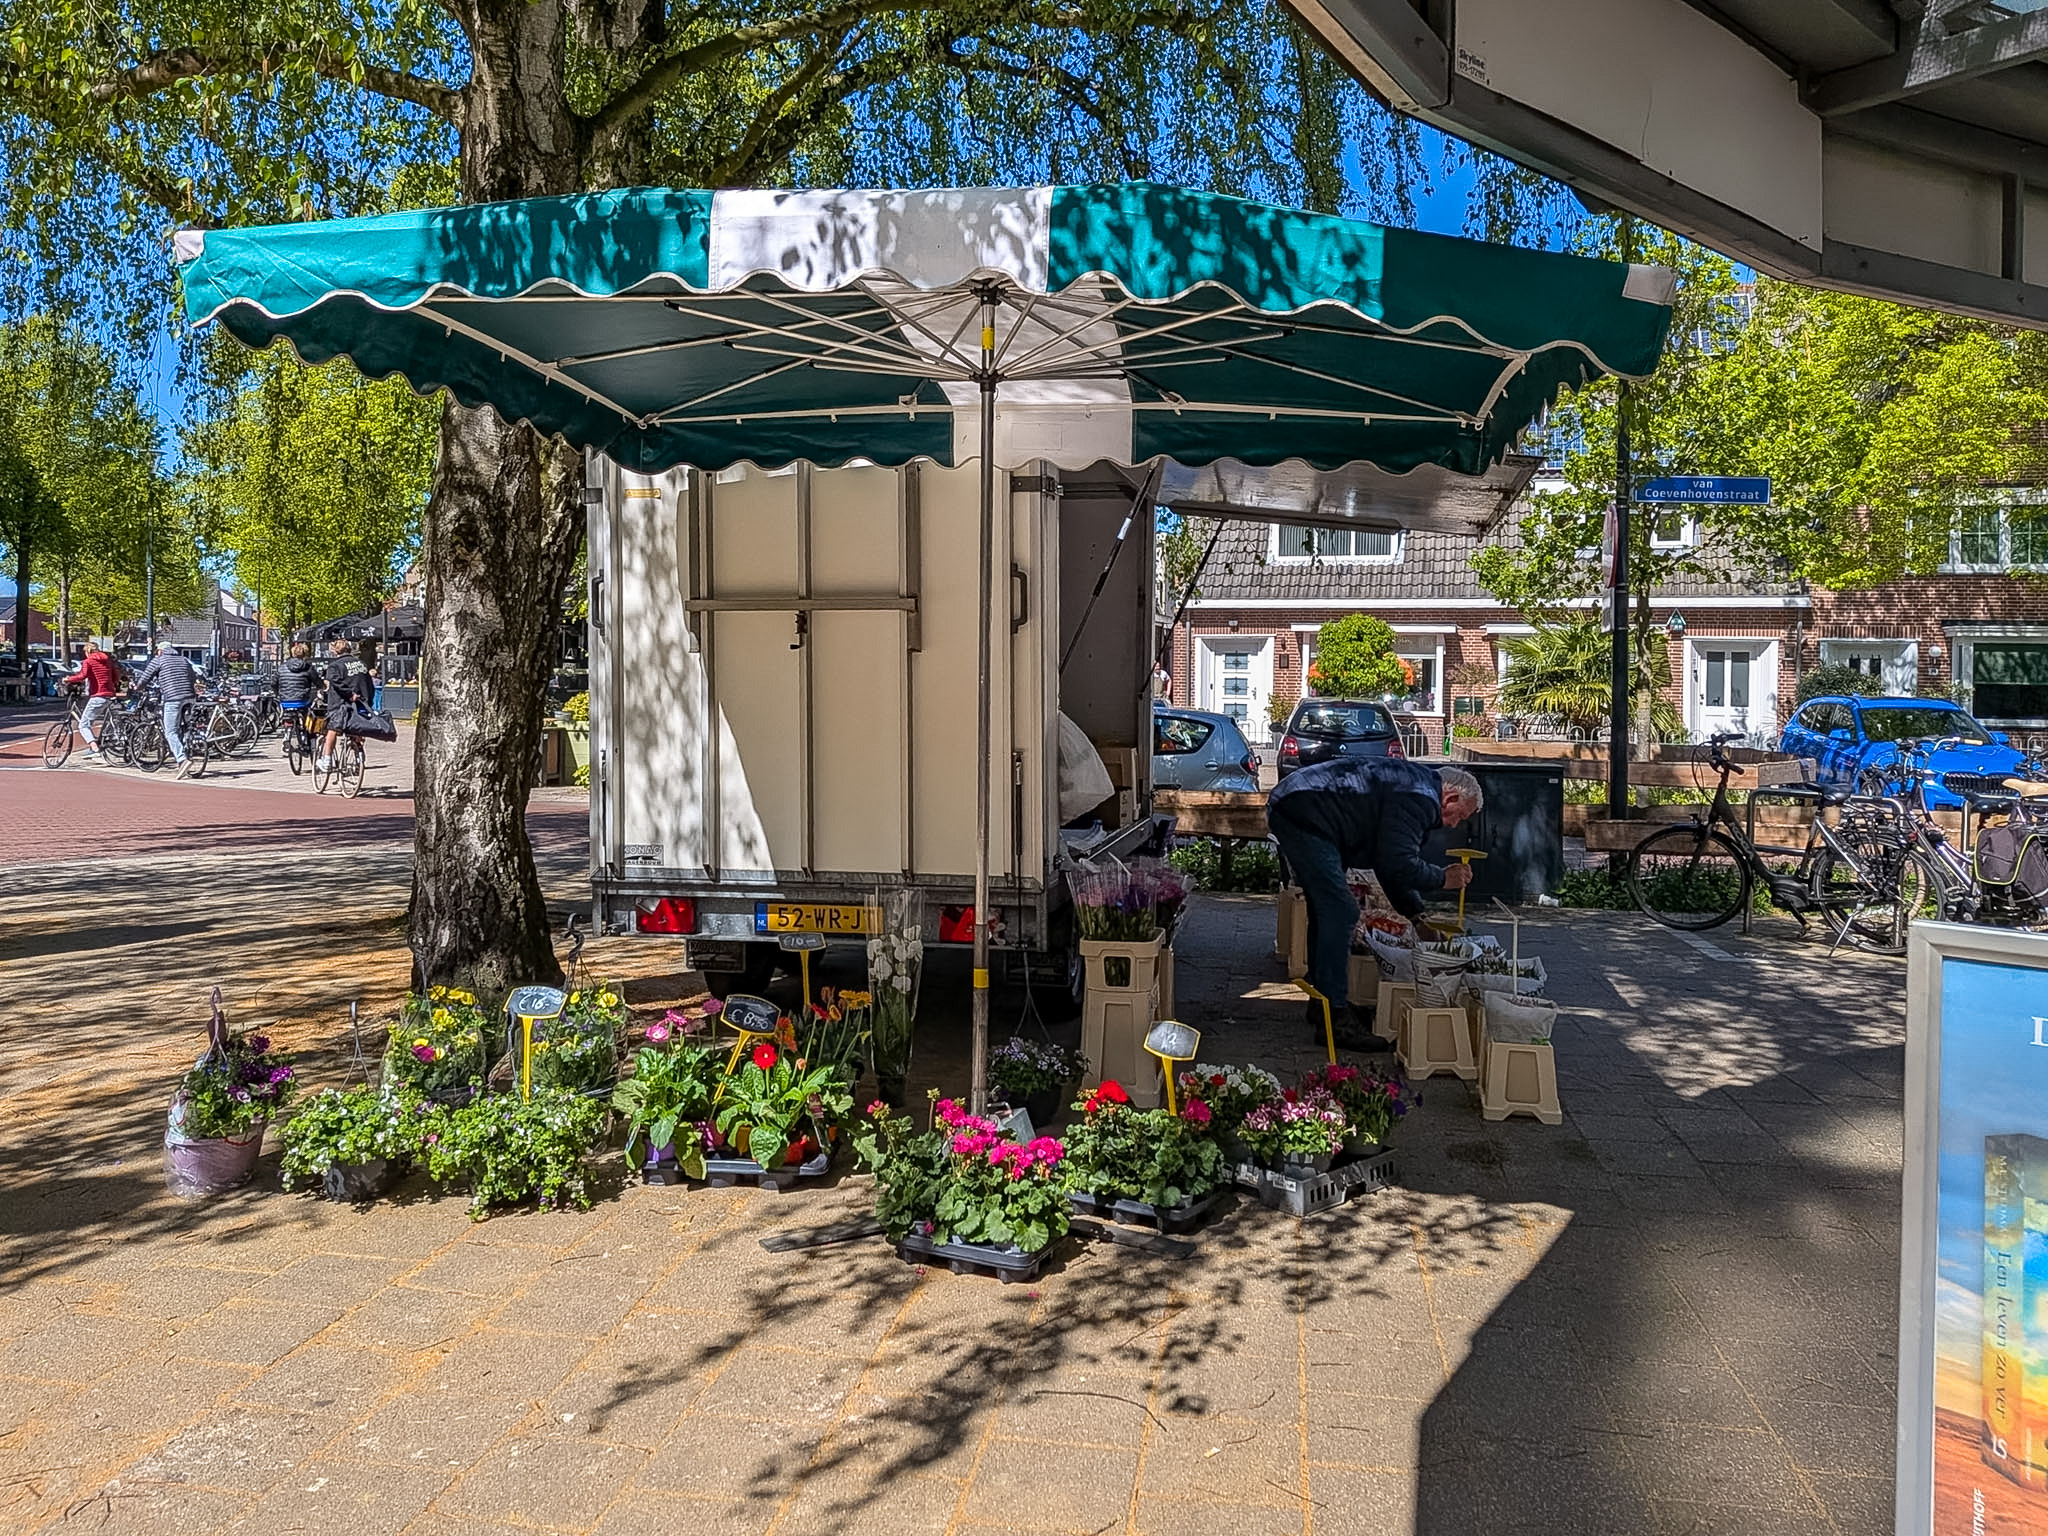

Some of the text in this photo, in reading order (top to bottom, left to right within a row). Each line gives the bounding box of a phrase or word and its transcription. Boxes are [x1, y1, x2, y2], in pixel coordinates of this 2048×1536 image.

[1644, 488, 1760, 500] Coevenhovenstraat
[1692, 480, 1713, 488] van
[777, 907, 861, 930] 52-WR-J
[1997, 1252, 2012, 1288] Een
[1996, 1296, 2014, 1347] leven
[1995, 1354, 2008, 1378] zo
[1995, 1387, 2008, 1419] ver
